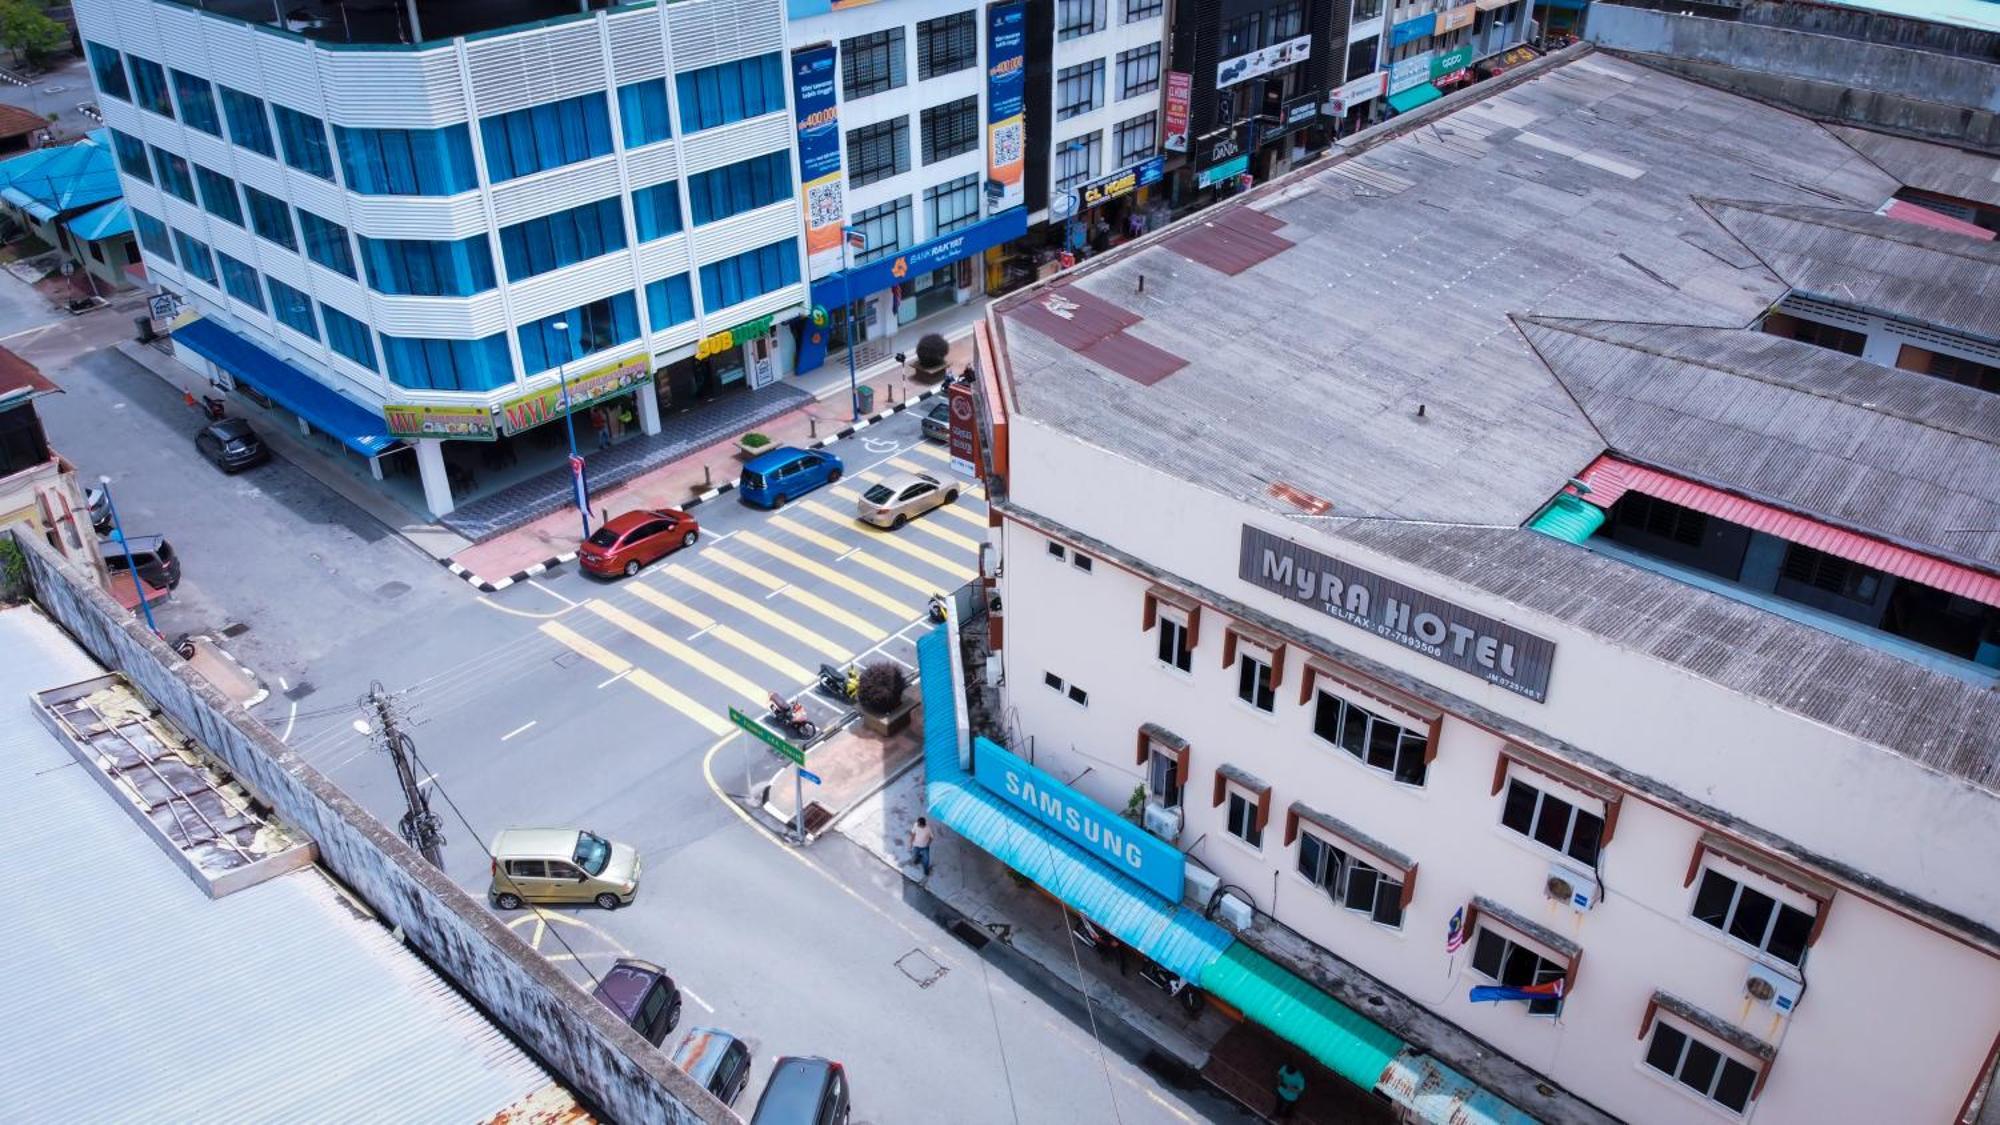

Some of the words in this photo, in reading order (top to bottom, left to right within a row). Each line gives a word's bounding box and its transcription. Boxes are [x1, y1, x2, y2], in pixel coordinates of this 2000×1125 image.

[1377, 625, 1441, 657] 07-7993506
[1487, 673, 1498, 682] JM
[1005, 771, 1143, 869] SAMSUNG
